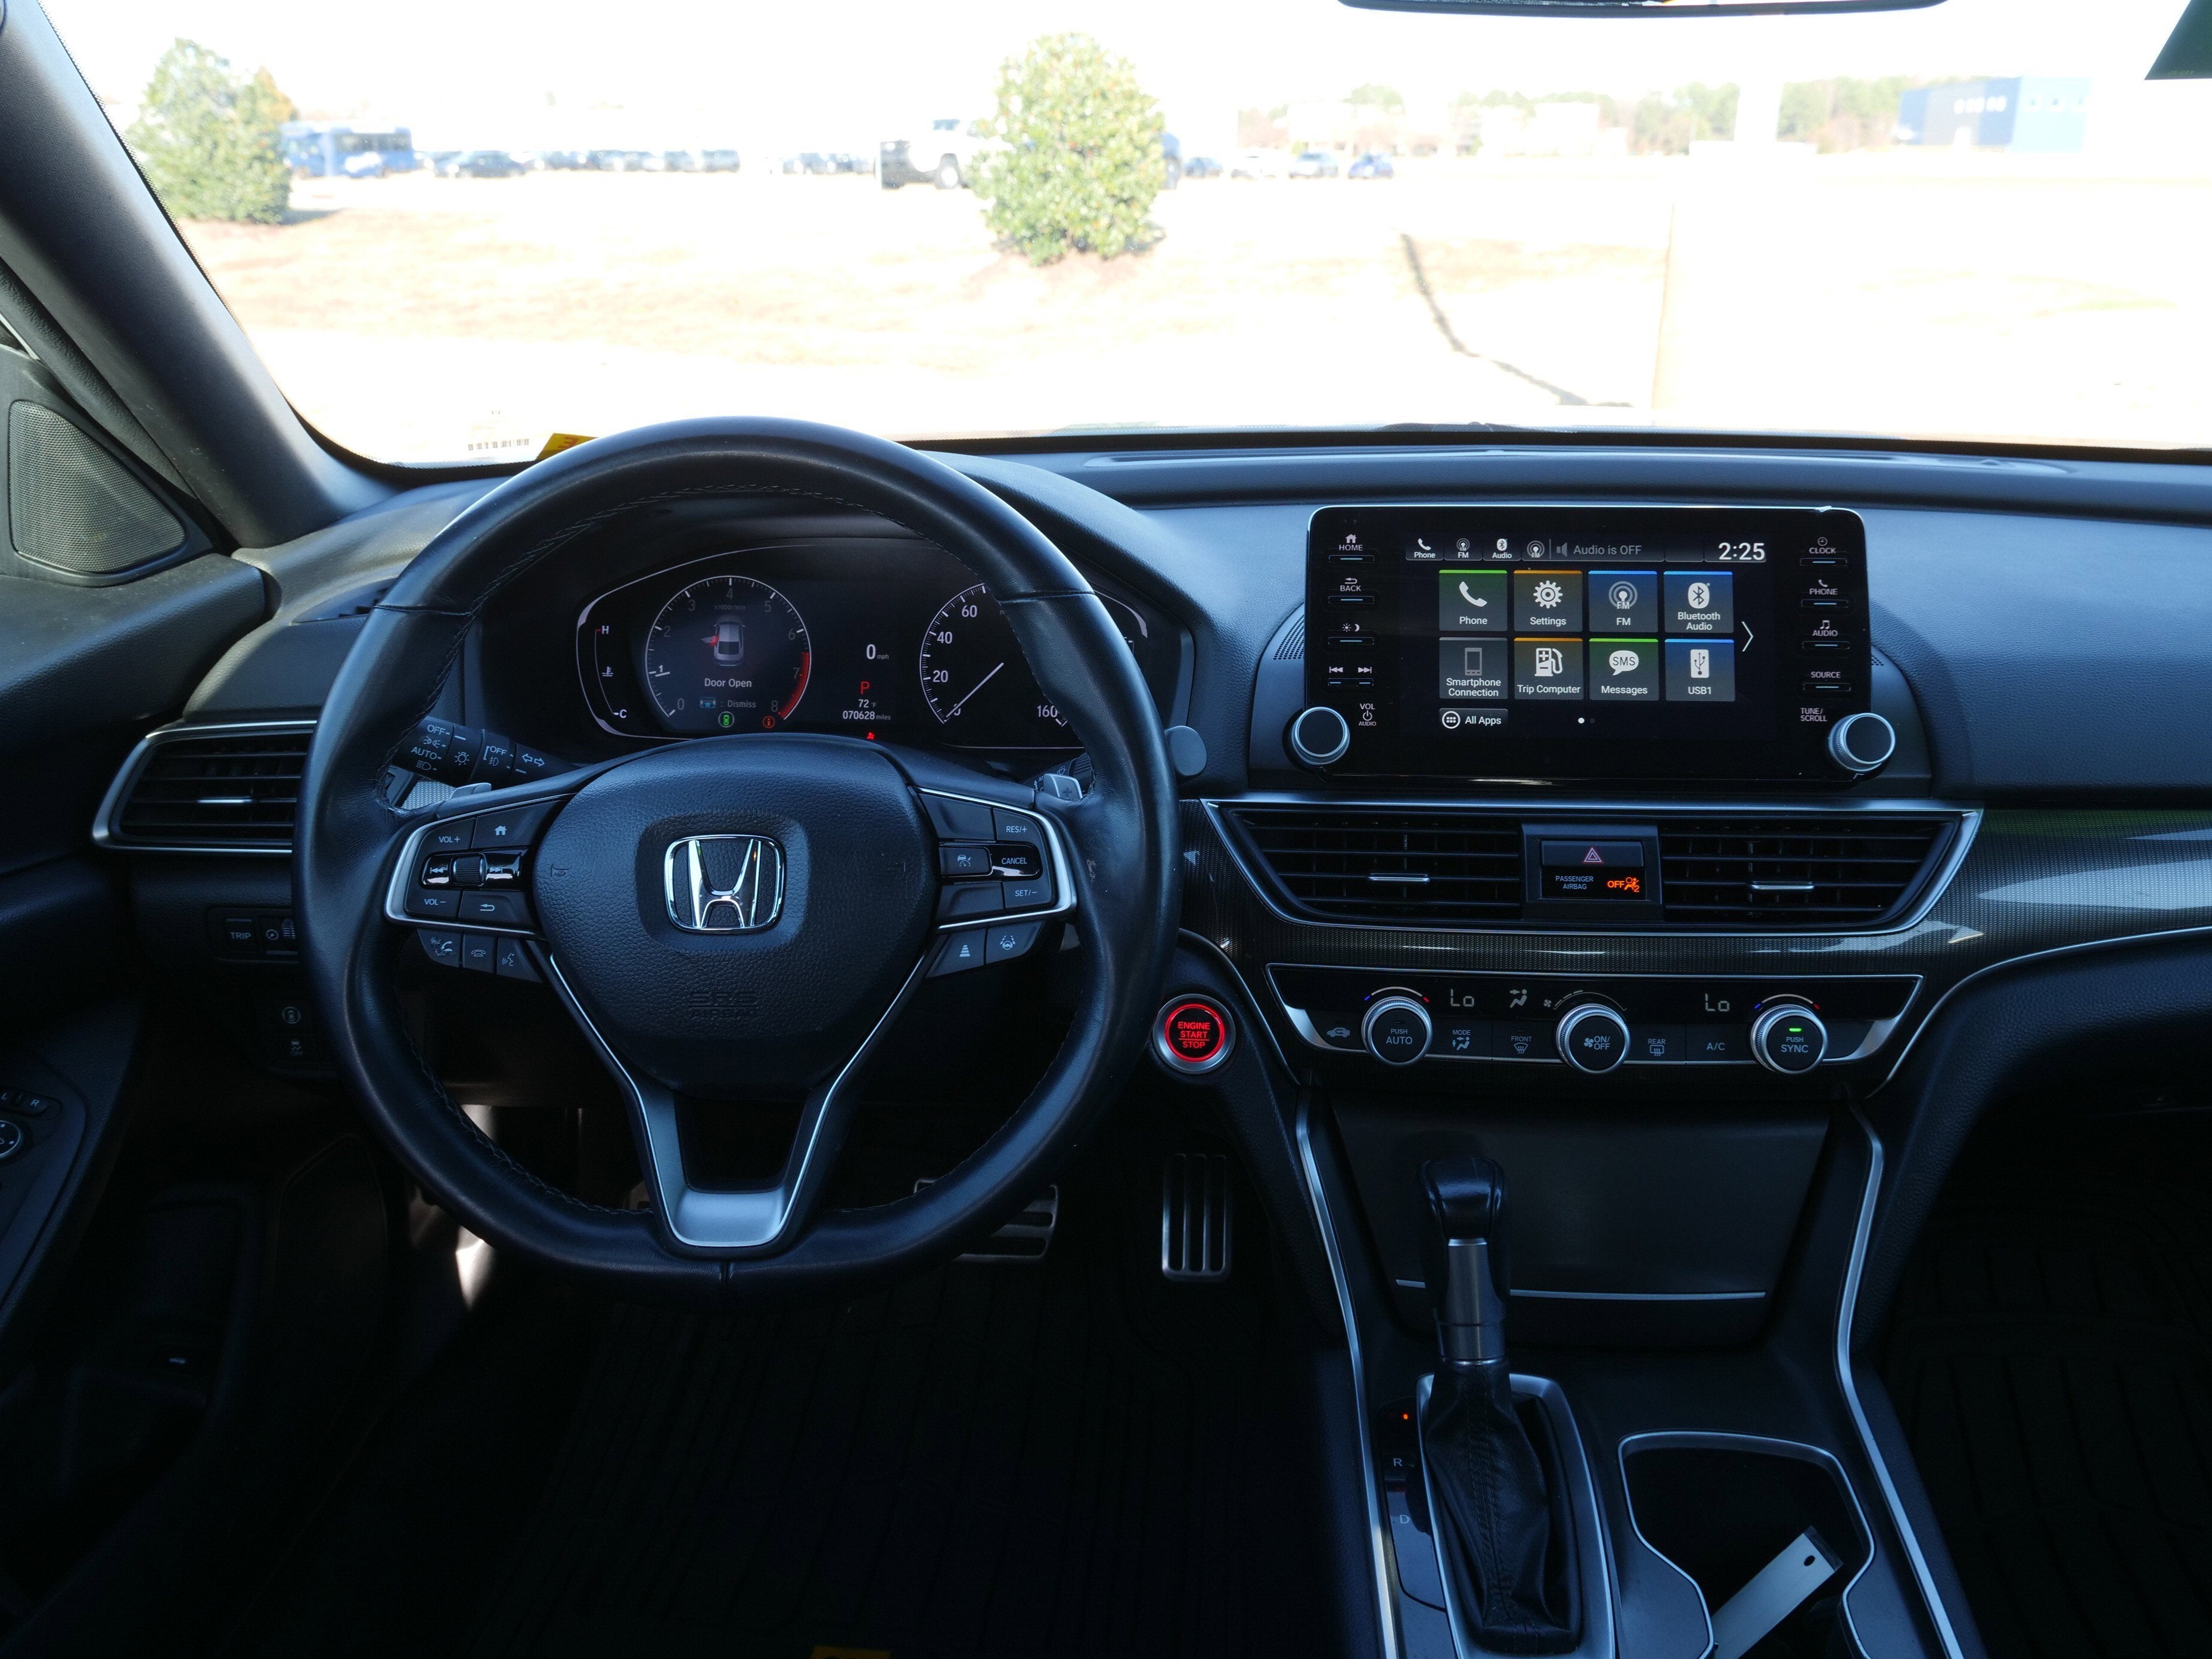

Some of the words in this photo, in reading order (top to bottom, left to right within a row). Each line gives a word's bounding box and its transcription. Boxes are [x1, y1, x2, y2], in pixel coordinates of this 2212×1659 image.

[1573, 545, 1605, 554] Audio
[1607, 545, 1618, 554] is
[1620, 545, 1643, 555] OFF
[1717, 542, 1766, 561] 2:25
[726, 587, 734, 599] 4
[688, 600, 696, 611] 3
[764, 601, 772, 613] 5
[961, 605, 977, 617] 60
[1677, 611, 1721, 621] Bluetooth
[1459, 616, 1488, 625] Phone
[1530, 616, 1567, 627] Settings
[1616, 617, 1632, 626] FM
[601, 625, 610, 635] H
[1686, 622, 1713, 631] Audio
[664, 626, 671, 638] 2
[788, 628, 796, 640] 6
[937, 632, 953, 644] 40
[866, 644, 877, 660] 0
[1613, 656, 1636, 666] SMS
[658, 664, 663, 673] 1
[793, 667, 800, 679] 7
[933, 670, 949, 683] 20
[704, 678, 726, 687] Door
[728, 678, 753, 688] Open
[860, 680, 871, 695] P
[1446, 678, 1502, 688] Smartphone
[1448, 688, 1499, 697] Connection
[1517, 685, 1534, 696] Trip
[1537, 685, 1581, 696] Computer
[1601, 686, 1648, 696] Messages
[1688, 686, 1712, 695] USB1
[677, 698, 685, 710] 0
[727, 700, 756, 708] Dismiss
[771, 700, 778, 712] 8
[858, 699, 869, 708] 72
[619, 709, 627, 719] C
[842, 710, 875, 720] 070628
[1036, 705, 1058, 717] 160
[1465, 716, 1477, 725] All
[1478, 716, 1502, 726] Apps
[427, 724, 446, 735] OFF
[411, 746, 438, 760] AUTO
[490, 745, 507, 757] OFF
[1001, 856, 1027, 866] CANCEL
[1555, 875, 1594, 883] PASSENGER
[1607, 880, 1625, 888] OFF
[229, 931, 251, 940] TRIP
[1178, 1021, 1211, 1030] ENGINE
[1180, 1030, 1208, 1039] START
[1593, 1035, 1610, 1043] ON/
[1182, 1041, 1206, 1049] STOP
[1386, 1036, 1413, 1045] AUTO
[1593, 1043, 1611, 1051] OFF
[1706, 1042, 1725, 1051] A/C
[1780, 1044, 1809, 1054] SYNC
[30, 1099, 41, 1107] R
[1393, 1458, 1403, 1467] R
[1400, 1514, 1410, 1524] D
